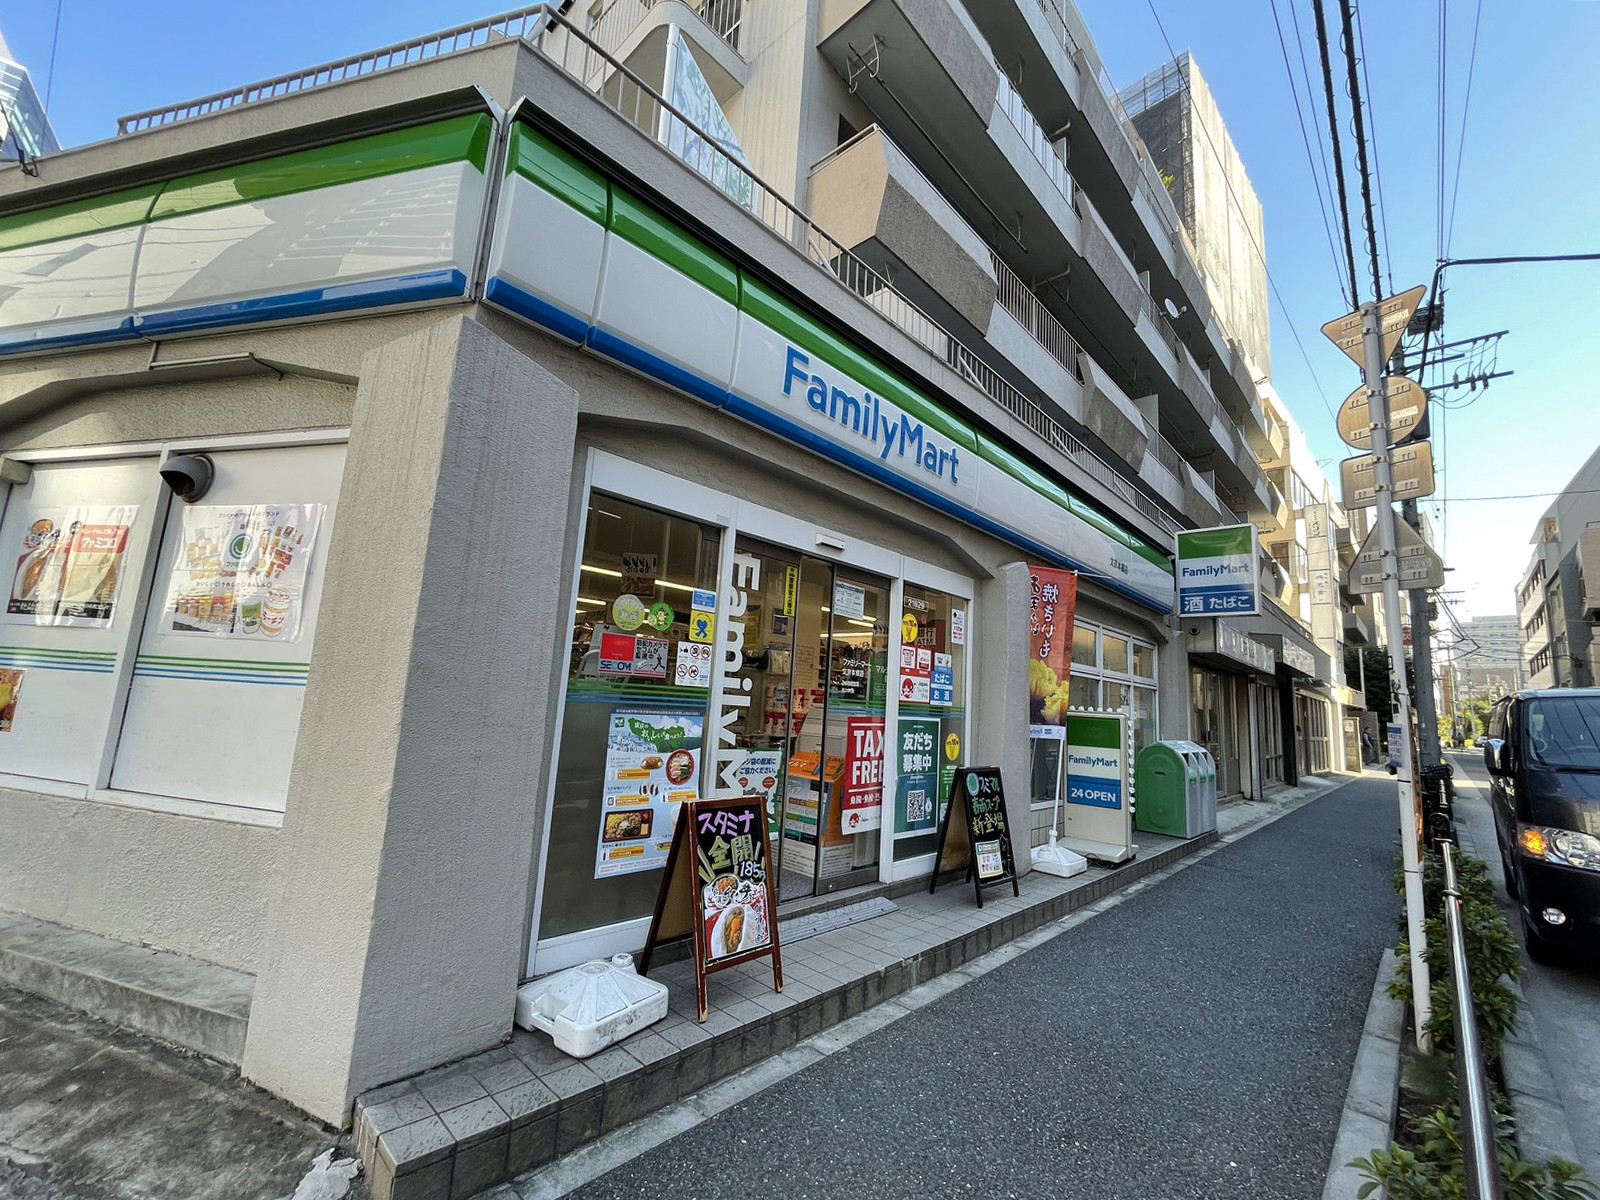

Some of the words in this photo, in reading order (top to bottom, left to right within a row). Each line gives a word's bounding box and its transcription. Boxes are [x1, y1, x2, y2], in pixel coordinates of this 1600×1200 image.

[783, 345, 960, 485] FamilyMart
[1182, 563, 1251, 577] FamilyMart
[1184, 596, 1204, 612] 酒
[1209, 595, 1251, 609] たばこ
[636, 639, 668, 649] 防犯カメラで
[600, 660, 631, 671] SECOM
[716, 556, 761, 797] FamilyM
[934, 673, 950, 684] たばこ
[853, 730, 884, 758] TAX
[903, 732, 932, 750] 友だち
[903, 754, 932, 772] 募集中
[1068, 754, 1118, 768] FamilyMart
[1071, 787, 1084, 799] 24
[1085, 788, 1117, 803] OPEN
[698, 810, 754, 836] スタミナ
[972, 811, 1006, 836] 新登場
[708, 834, 754, 870] 全開
